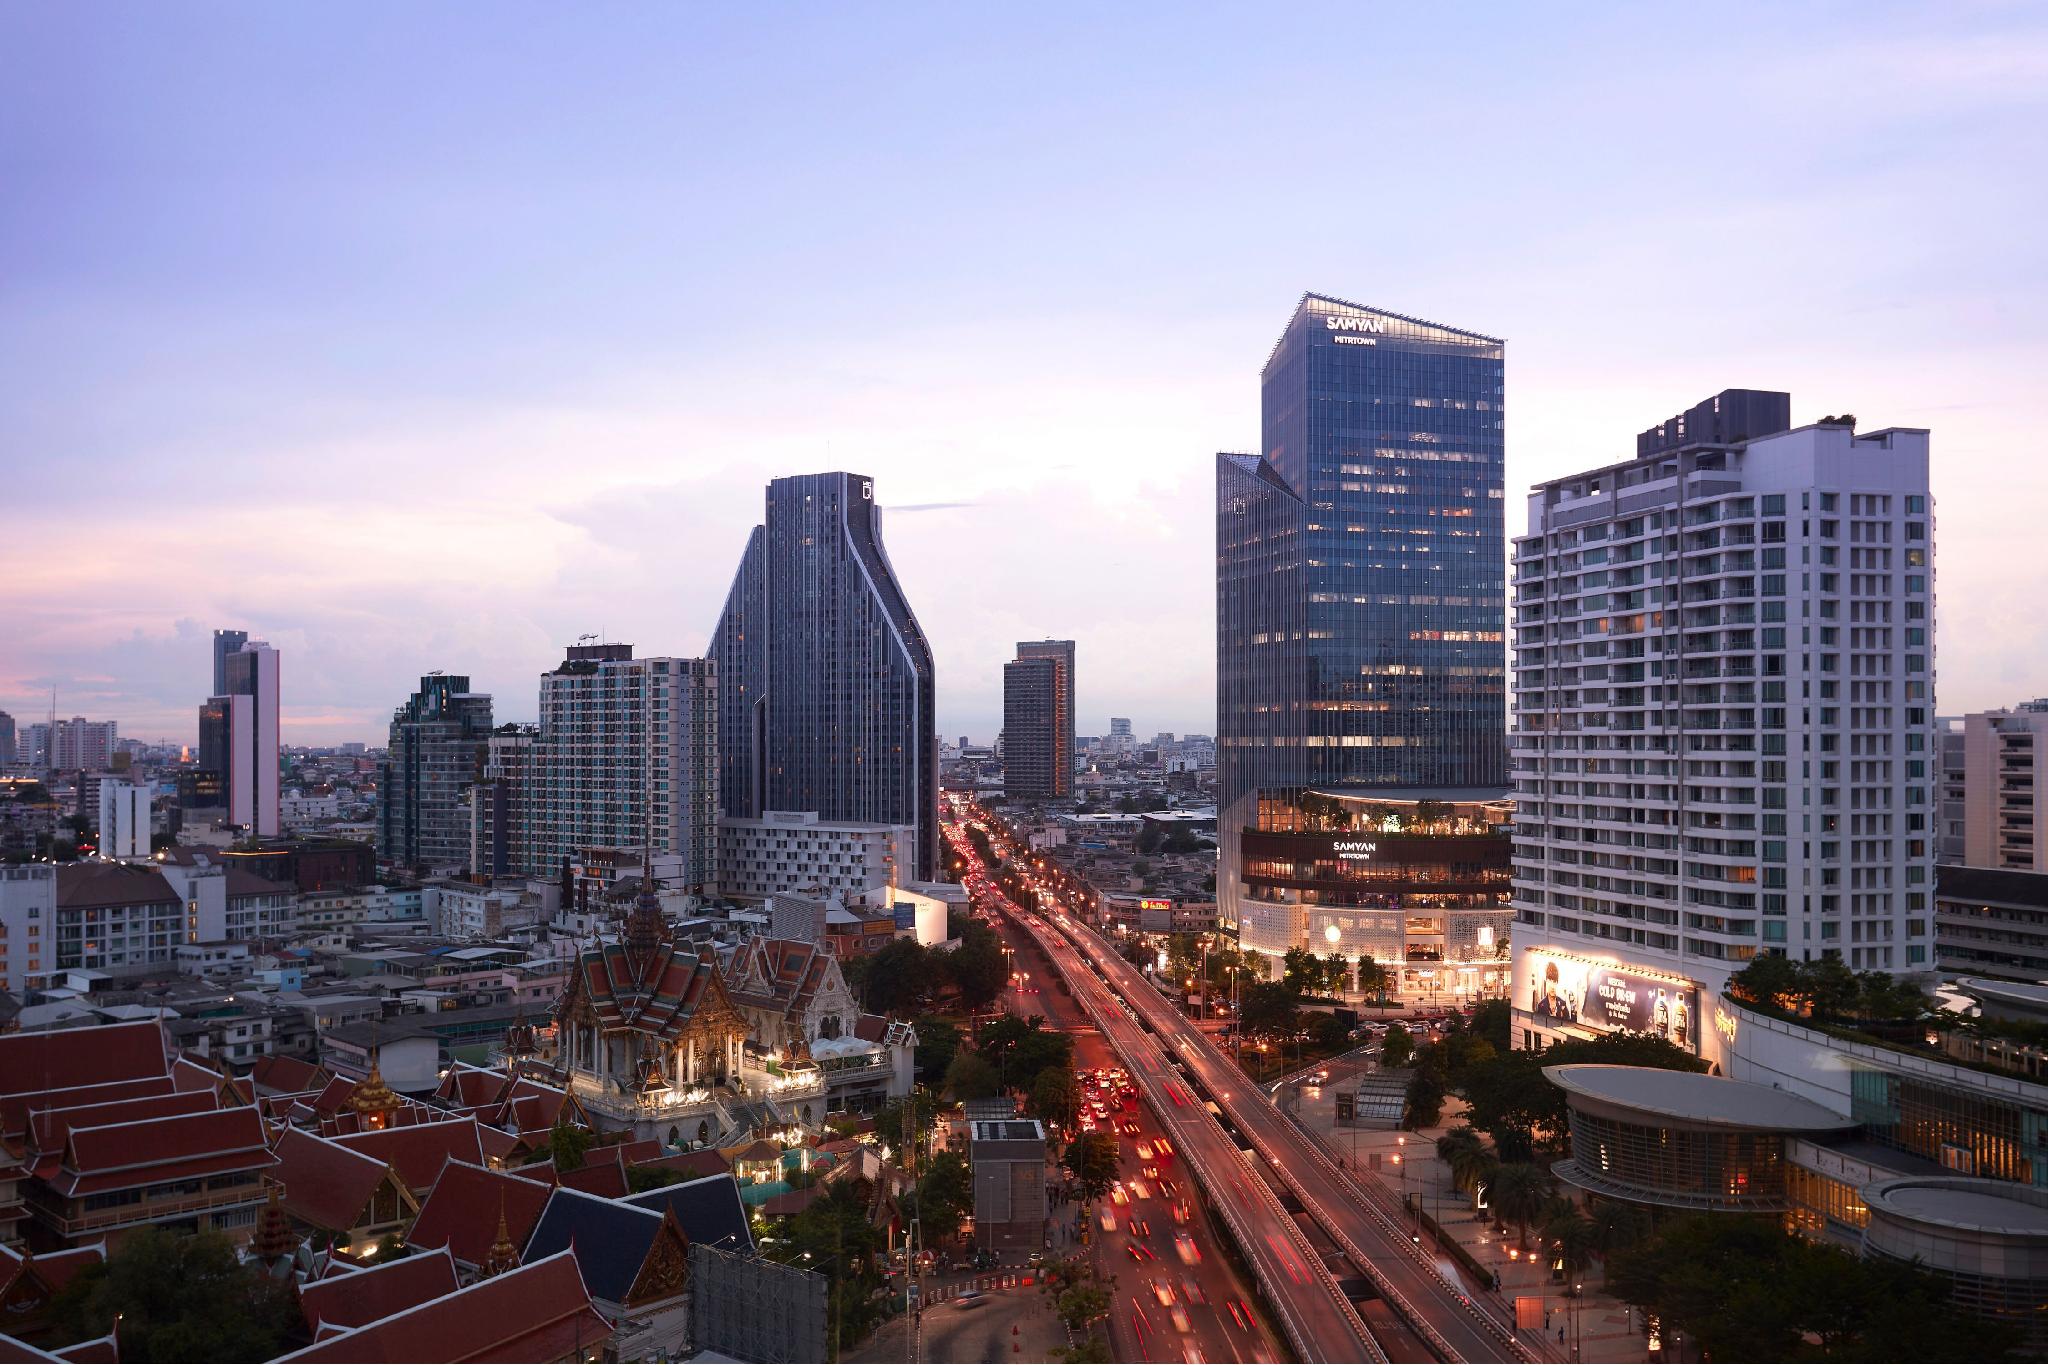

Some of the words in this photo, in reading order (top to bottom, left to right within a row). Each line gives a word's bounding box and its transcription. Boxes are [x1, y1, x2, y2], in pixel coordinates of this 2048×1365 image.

[1326, 316, 1383, 333] SAMYAN
[1334, 336, 1376, 346] MITRTOWN
[1333, 842, 1376, 852] SAMYAN
